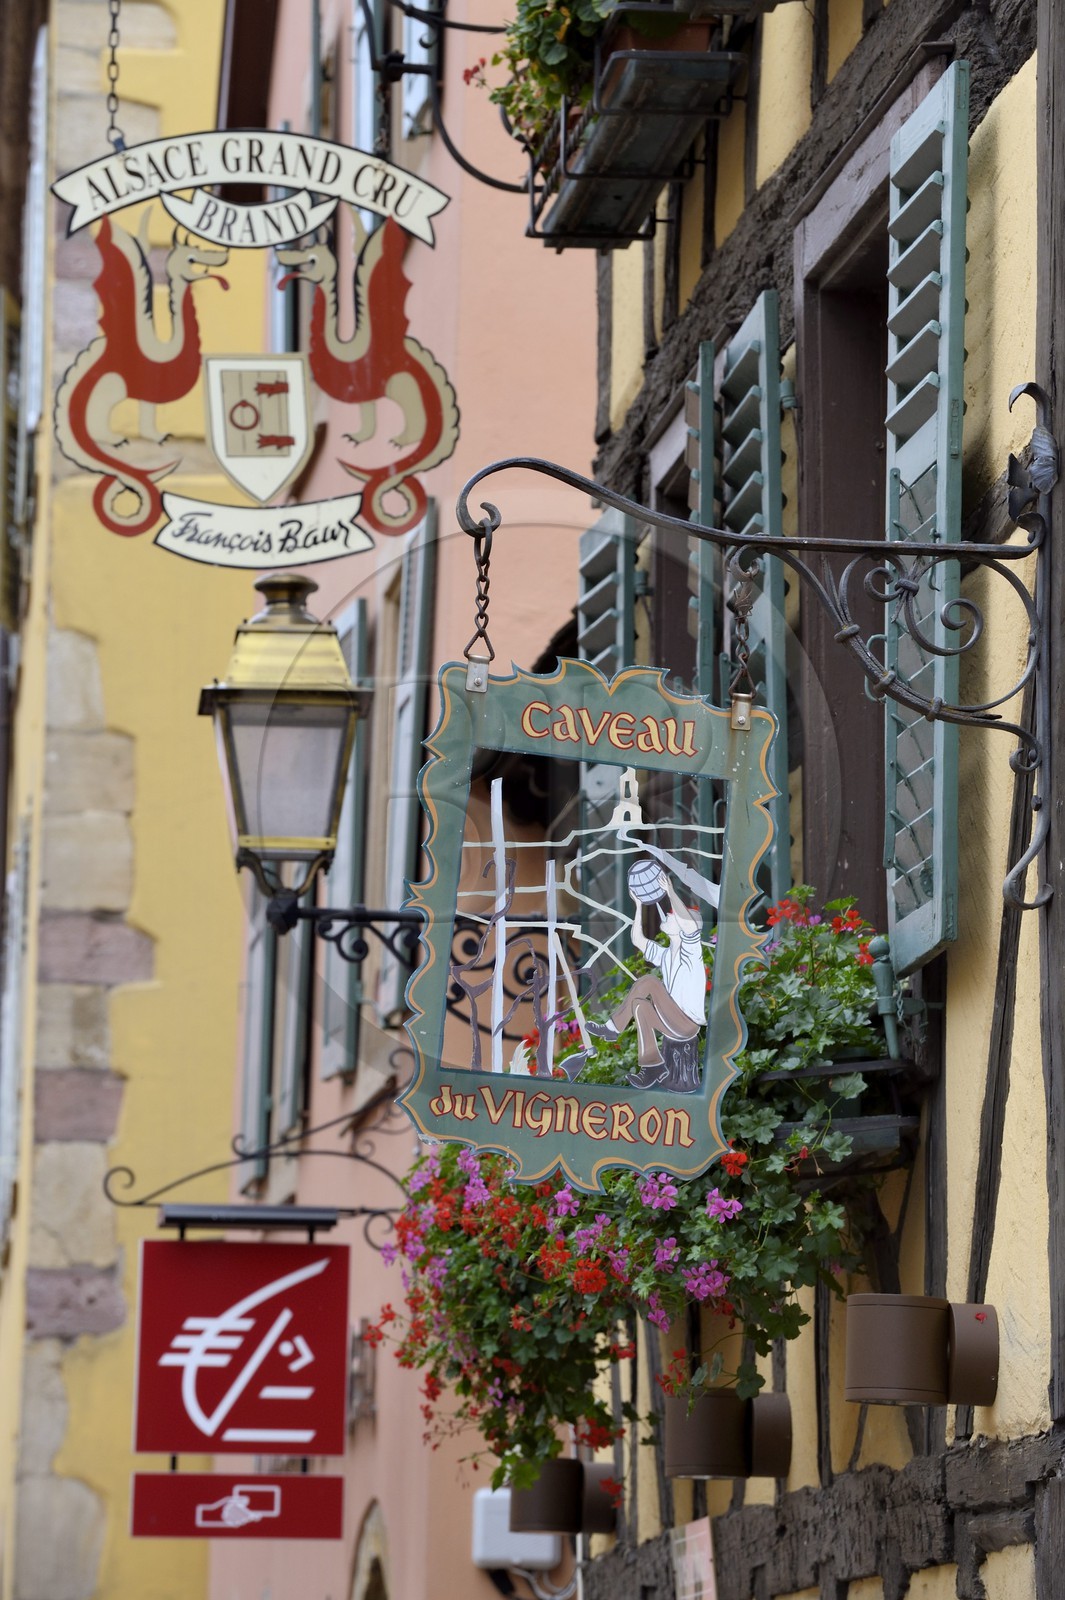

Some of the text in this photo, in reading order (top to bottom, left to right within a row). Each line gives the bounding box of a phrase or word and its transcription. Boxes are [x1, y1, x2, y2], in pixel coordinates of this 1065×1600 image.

[86, 138, 422, 218] ALSACE GRAND CRU
[196, 201, 308, 244] BRAND
[172, 512, 350, 554] François Baur
